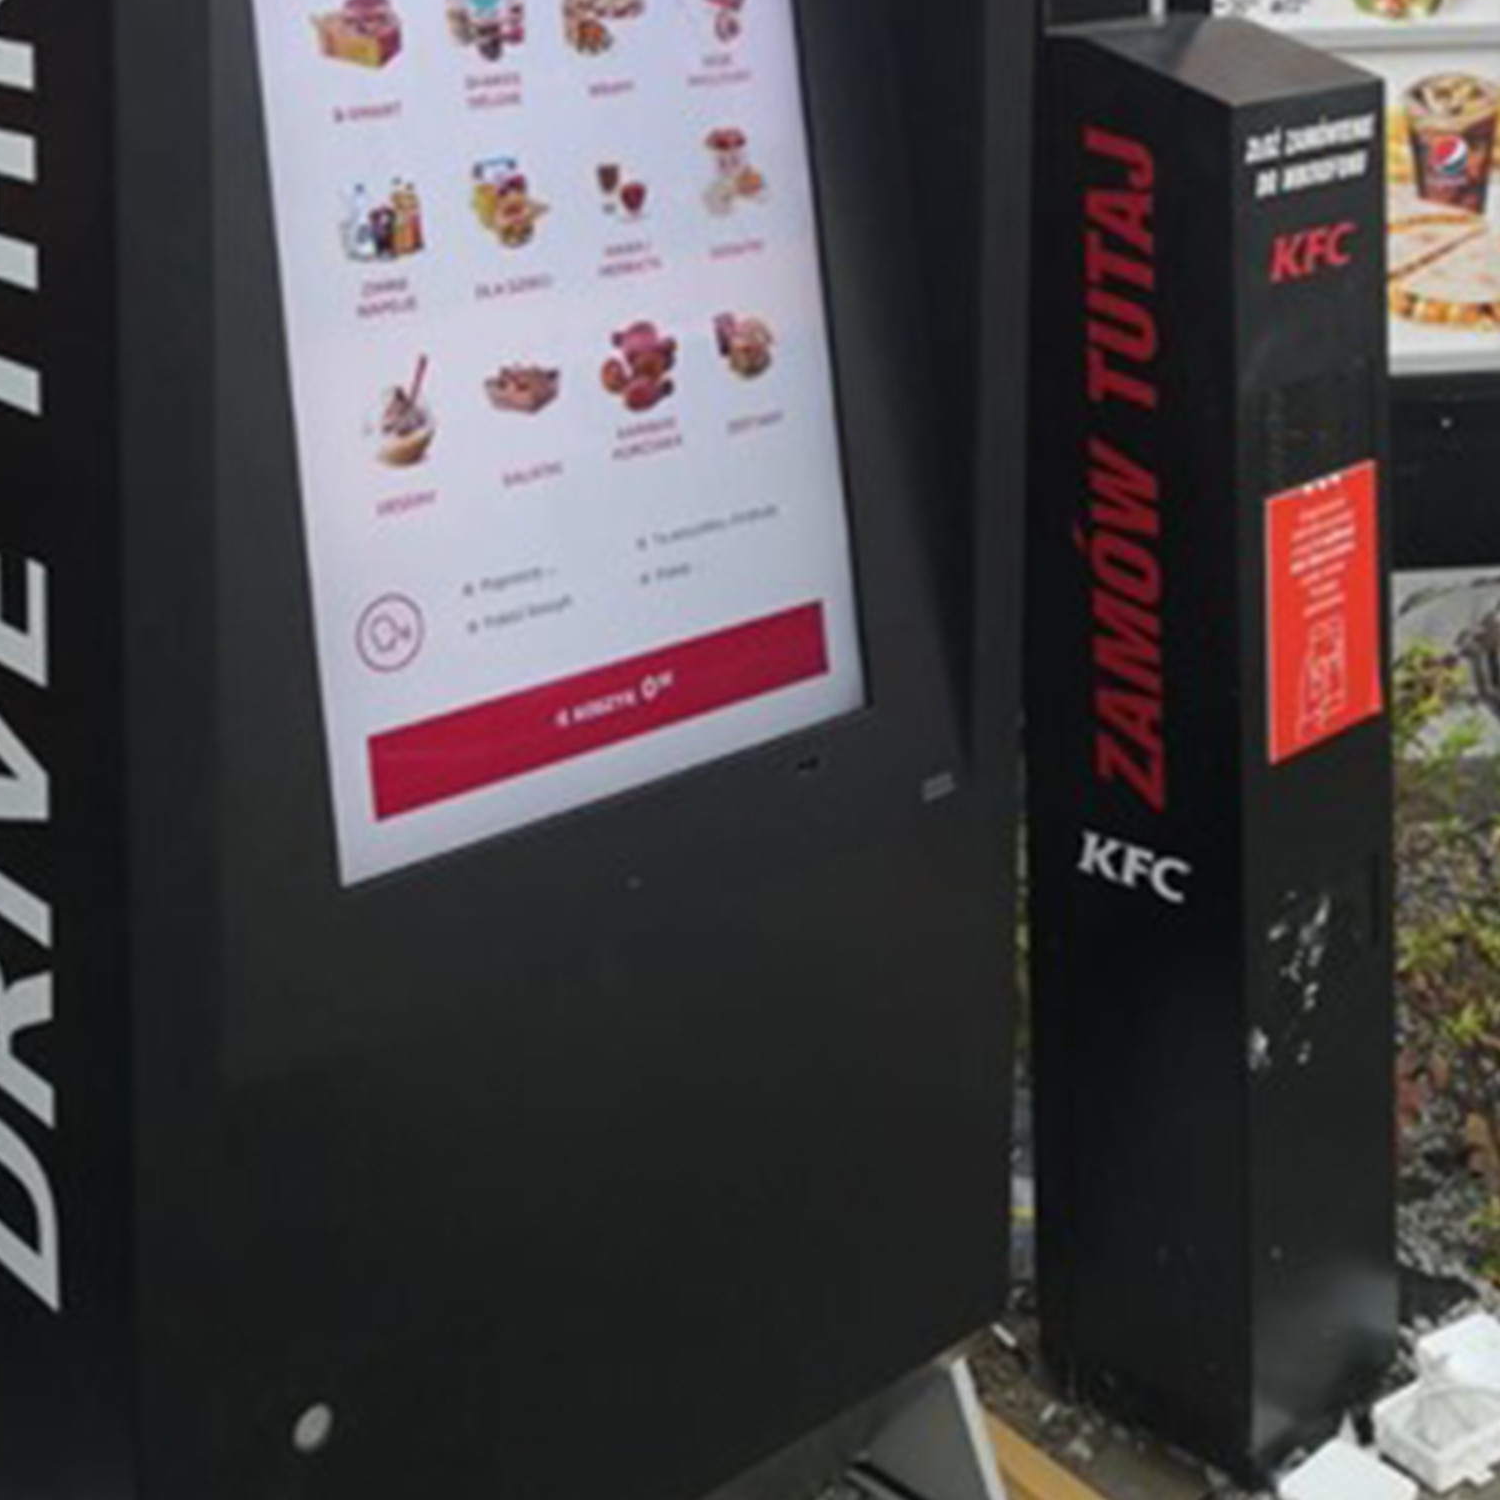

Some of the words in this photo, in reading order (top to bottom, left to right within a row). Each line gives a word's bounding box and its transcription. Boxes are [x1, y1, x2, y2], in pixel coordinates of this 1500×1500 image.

[1084, 124, 1160, 409] TUTAJ
[1269, 222, 1358, 283] KFC
[1073, 438, 1165, 813] ZAMÓW
[1076, 830, 1192, 905] KFC
